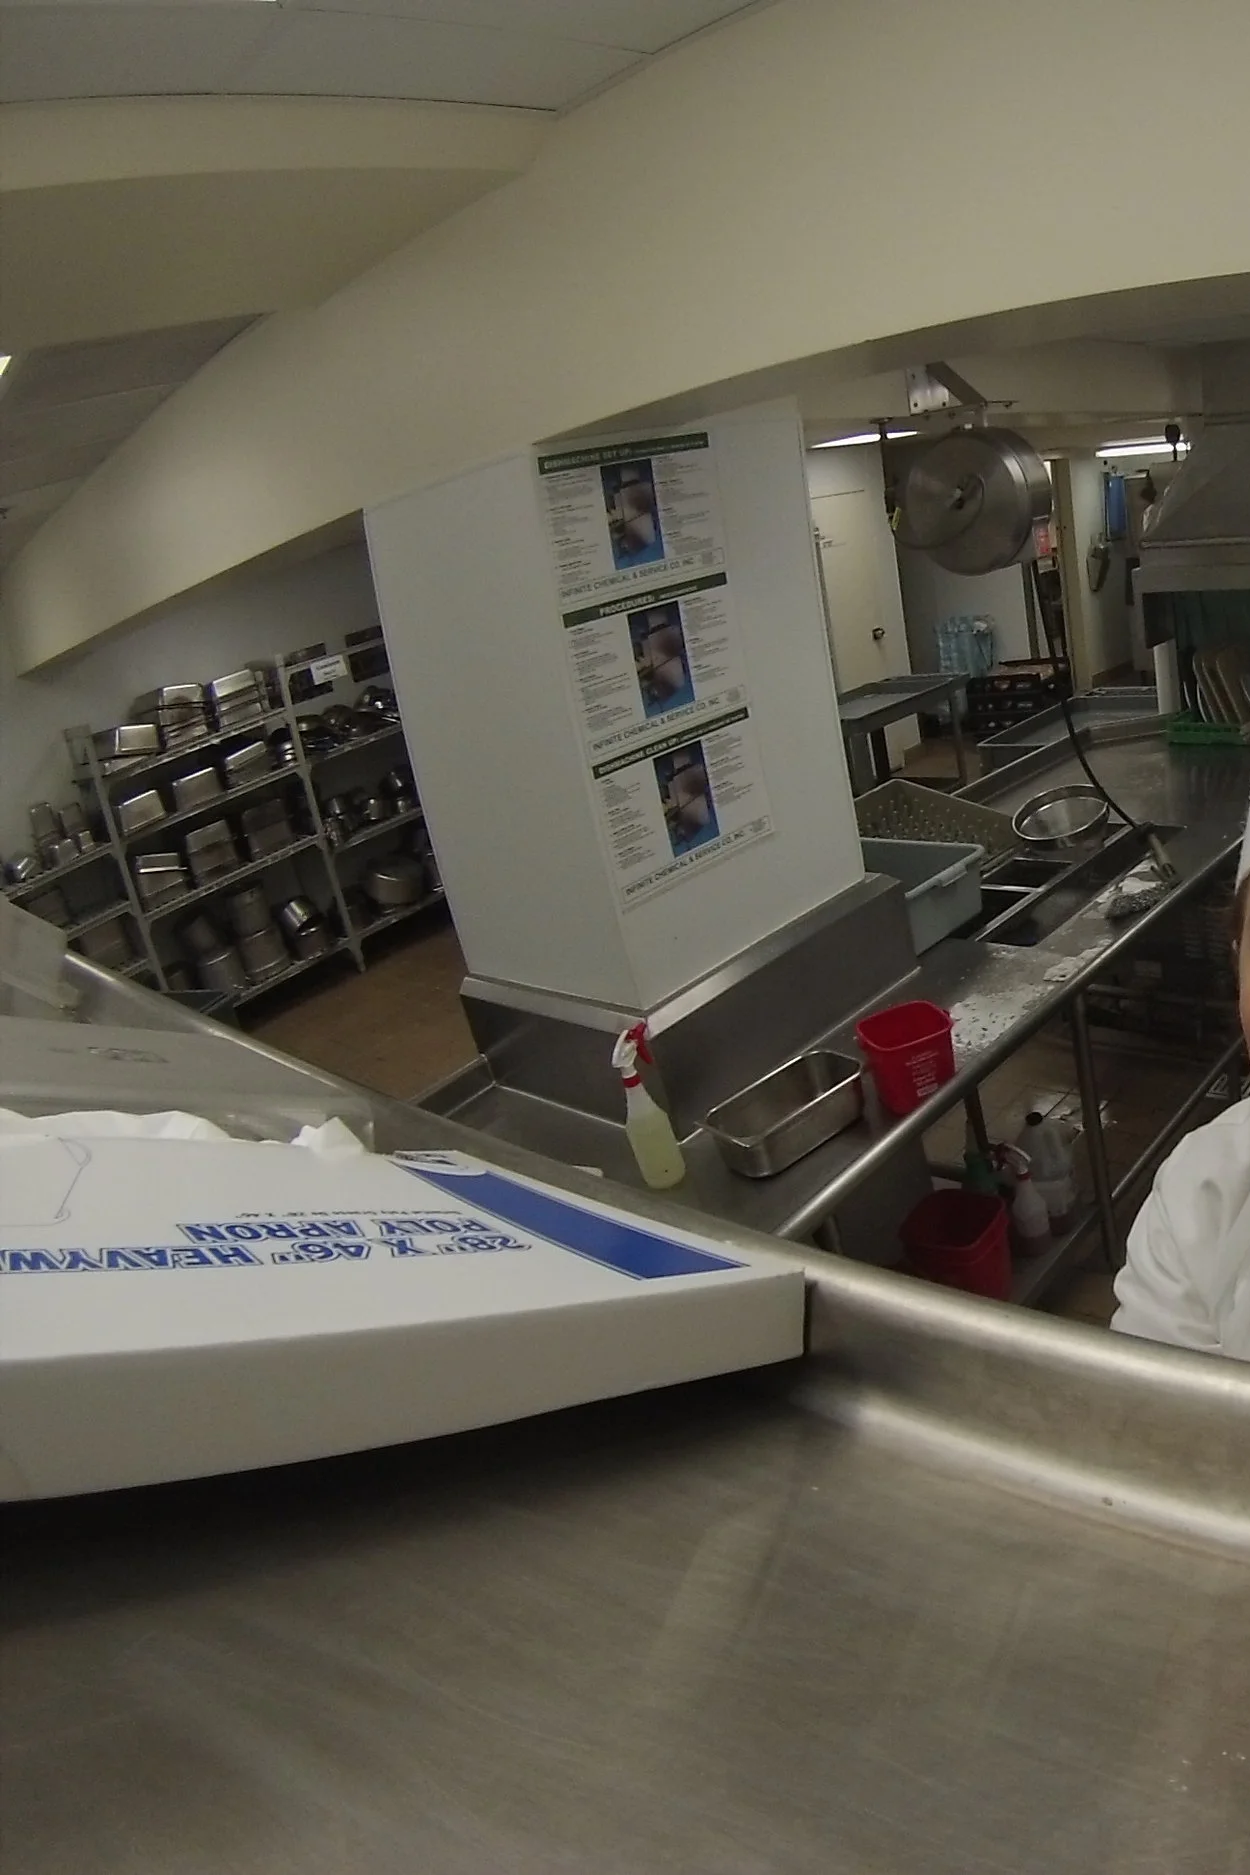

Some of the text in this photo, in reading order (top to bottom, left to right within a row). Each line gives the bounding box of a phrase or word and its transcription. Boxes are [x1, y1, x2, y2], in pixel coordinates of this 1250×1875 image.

[561, 583, 593, 598] INFINITE
[594, 574, 630, 590] CHEMICAL
[639, 564, 668, 579] SERVICE
[593, 735, 623, 750] INFINITE
[624, 721, 658, 738] CHEMICAL
[667, 707, 694, 722] SERVICE
[626, 876, 653, 896] INFINITE
[655, 860, 687, 880] CHEMICAL
[696, 842, 721, 860] SERVICE
[177, 1218, 495, 1243] POLY APRON
[0, 1235, 530, 1274] 28" X 46" HEAVYW
